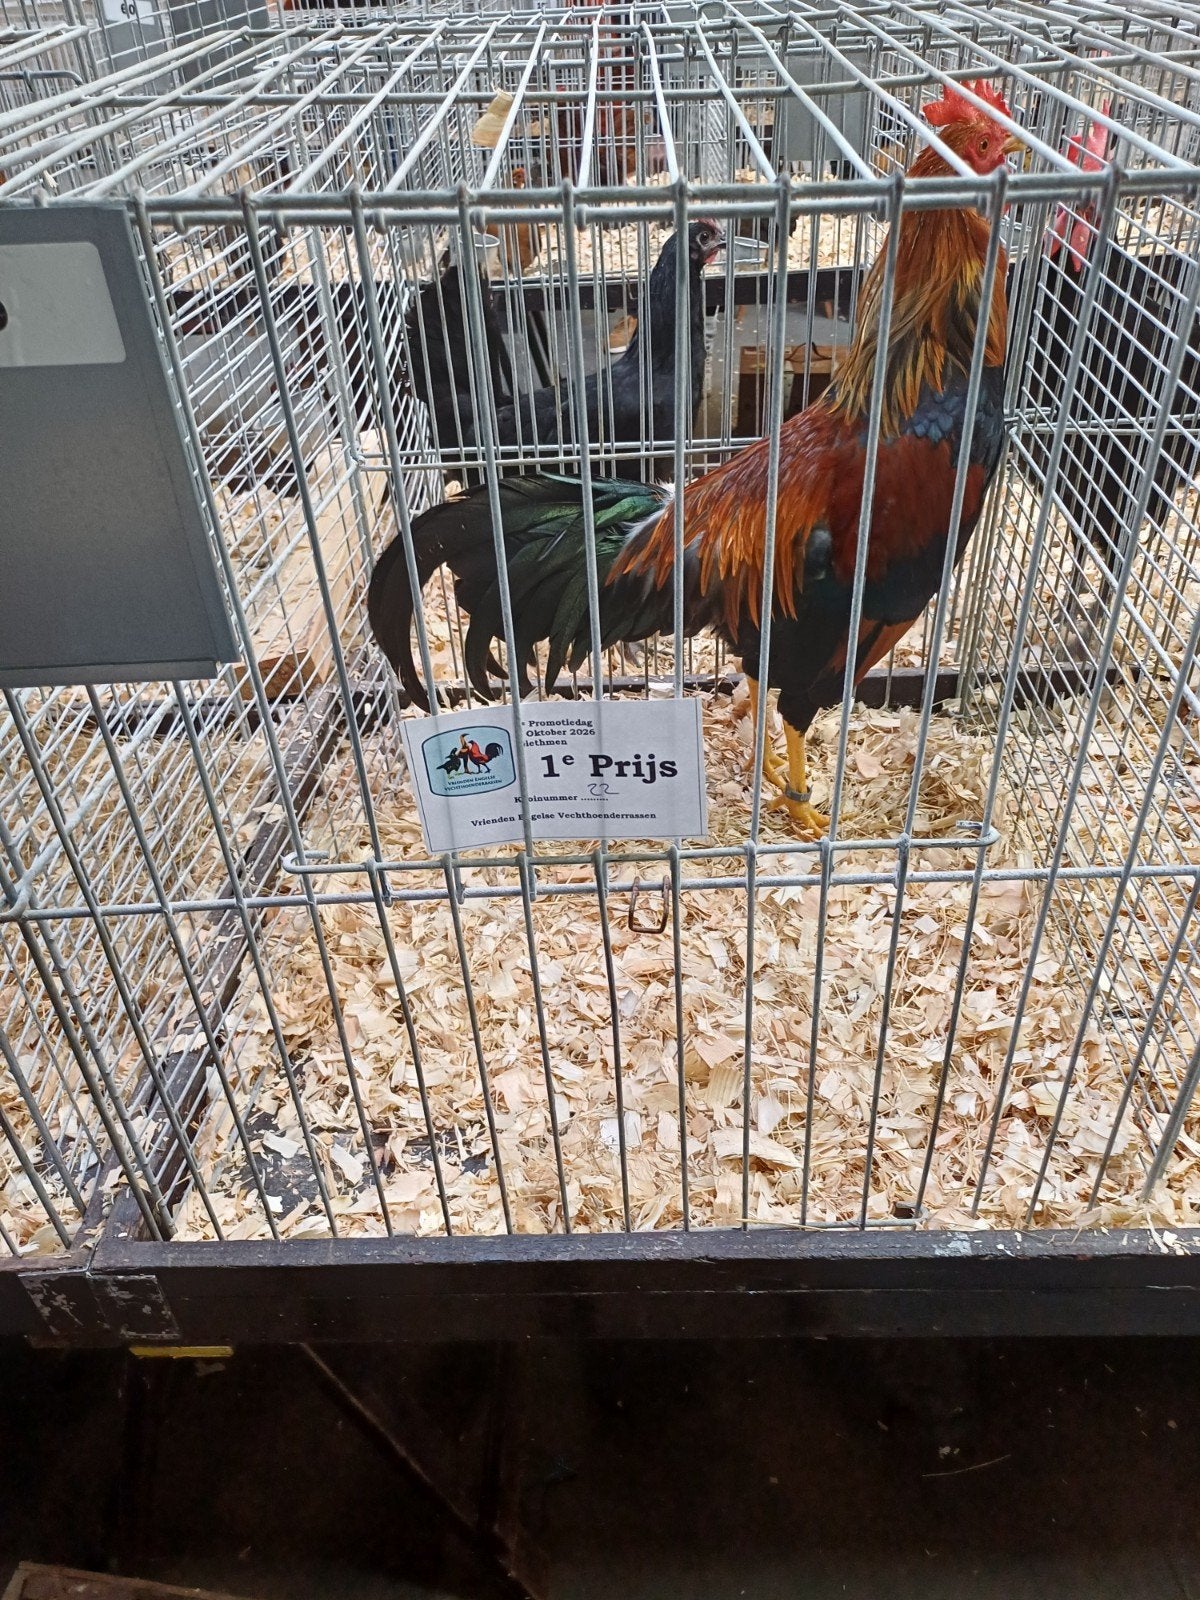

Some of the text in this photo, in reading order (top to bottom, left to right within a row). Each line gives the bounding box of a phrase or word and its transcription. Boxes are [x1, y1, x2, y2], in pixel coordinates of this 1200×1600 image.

[528, 718, 593, 727] Promotiedag
[569, 728, 596, 736] 2026
[523, 739, 567, 747] iethmen
[588, 753, 678, 784] Prijs
[514, 795, 578, 803] Koinummer
[471, 816, 515, 827] Vrienden
[518, 812, 555, 821] Egelse
